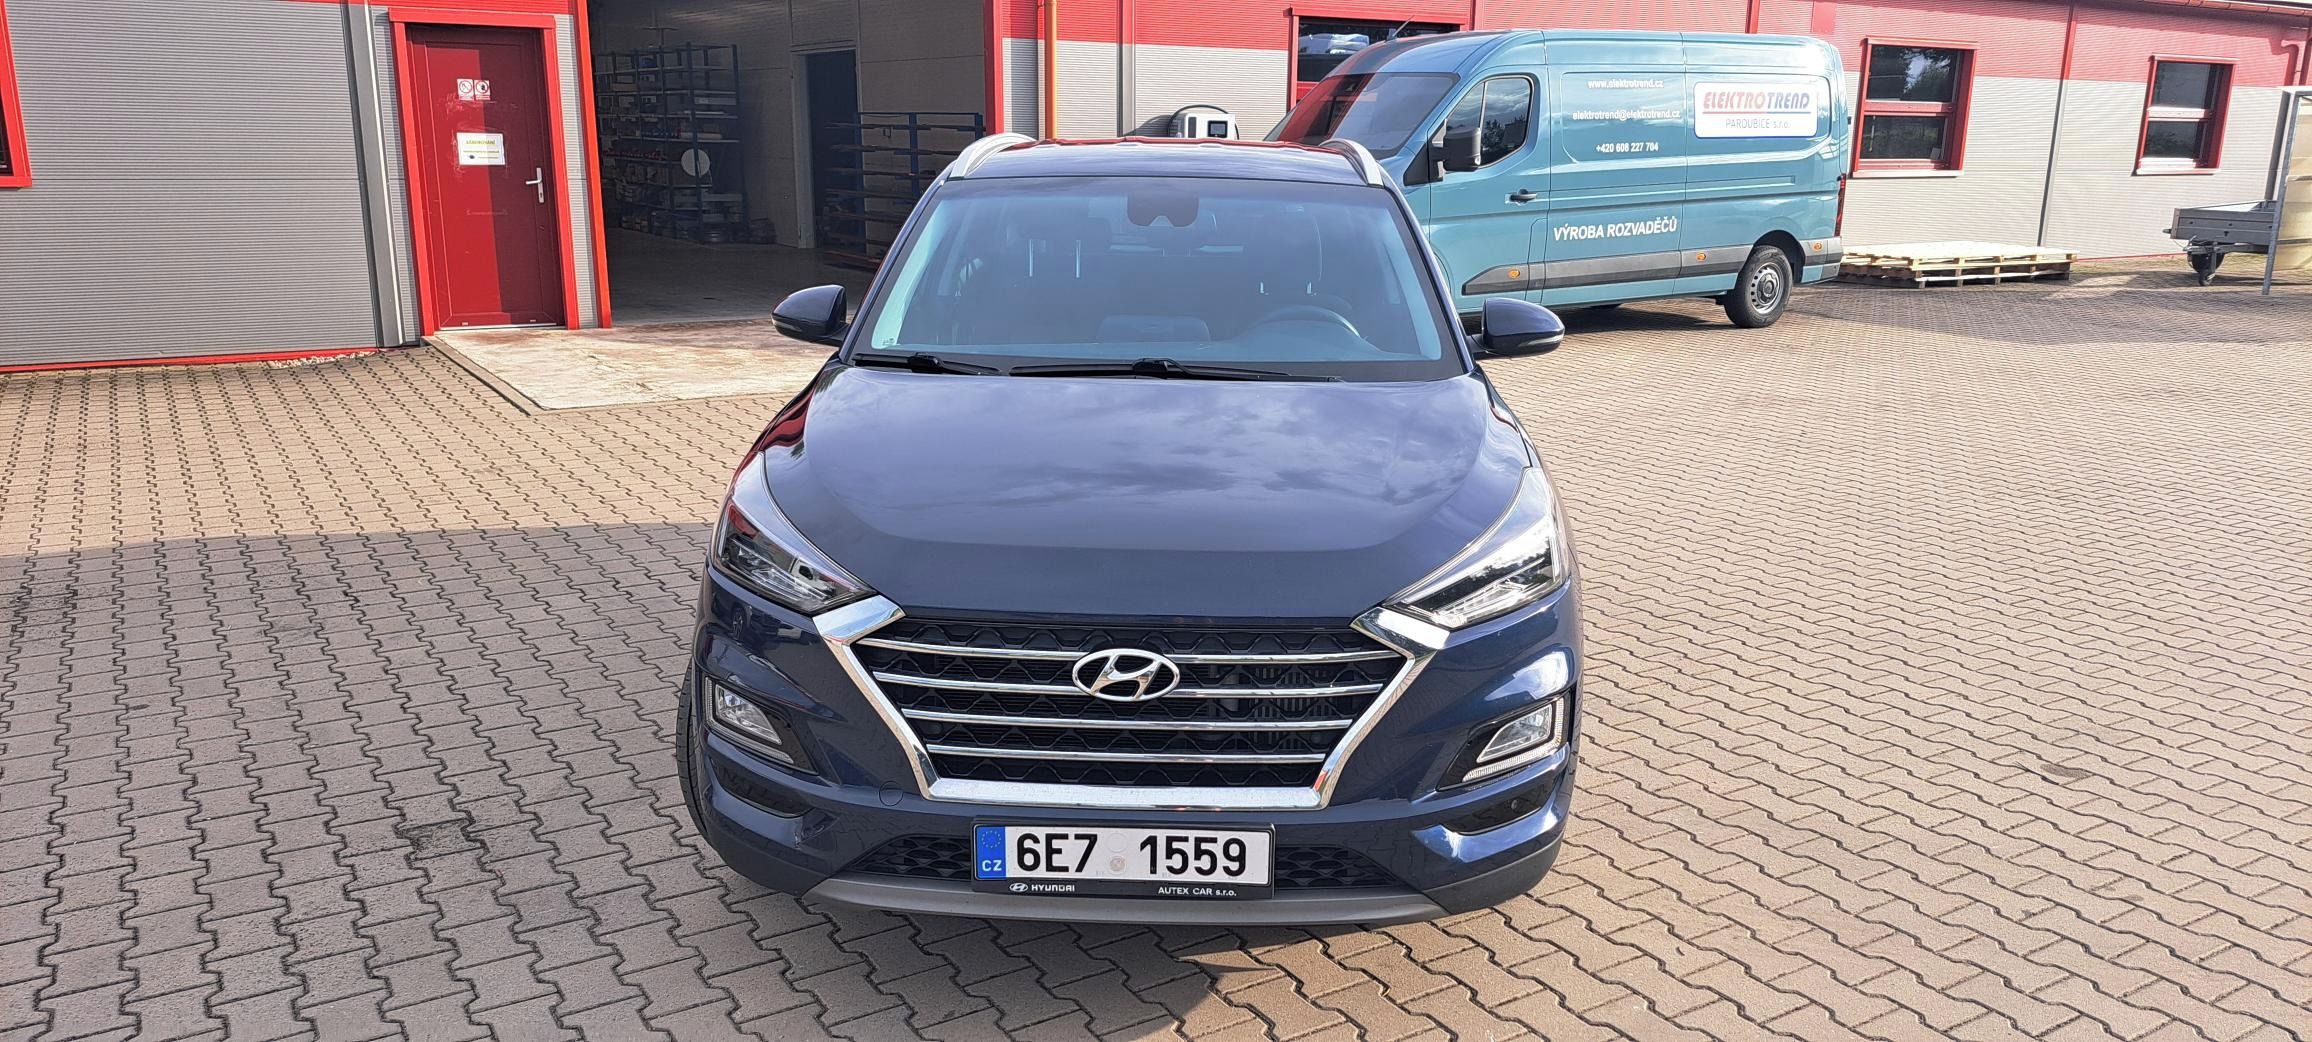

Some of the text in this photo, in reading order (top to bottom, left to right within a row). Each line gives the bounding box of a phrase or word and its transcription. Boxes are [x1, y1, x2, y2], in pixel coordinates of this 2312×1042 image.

[1587, 79, 1664, 89] www.elektrotrend.cz
[1703, 91, 1810, 109] ELEKTROTREND
[1572, 109, 1680, 121] elektrotrend@elektrotrend.cz
[1726, 118, 1770, 129] PARDUBICE
[1596, 144, 1614, 152] +420
[1631, 142, 1644, 152] 227
[1646, 142, 1659, 151] 704
[1553, 216, 1677, 241] VÝROBA ROZVADĚČŮ
[1016, 832, 1248, 877] 6E7 1559
[982, 860, 1002, 872] CZ
[1031, 884, 1075, 892] HYUNDAI
[1158, 886, 1238, 897] AUTEX CAR s.r.o.
